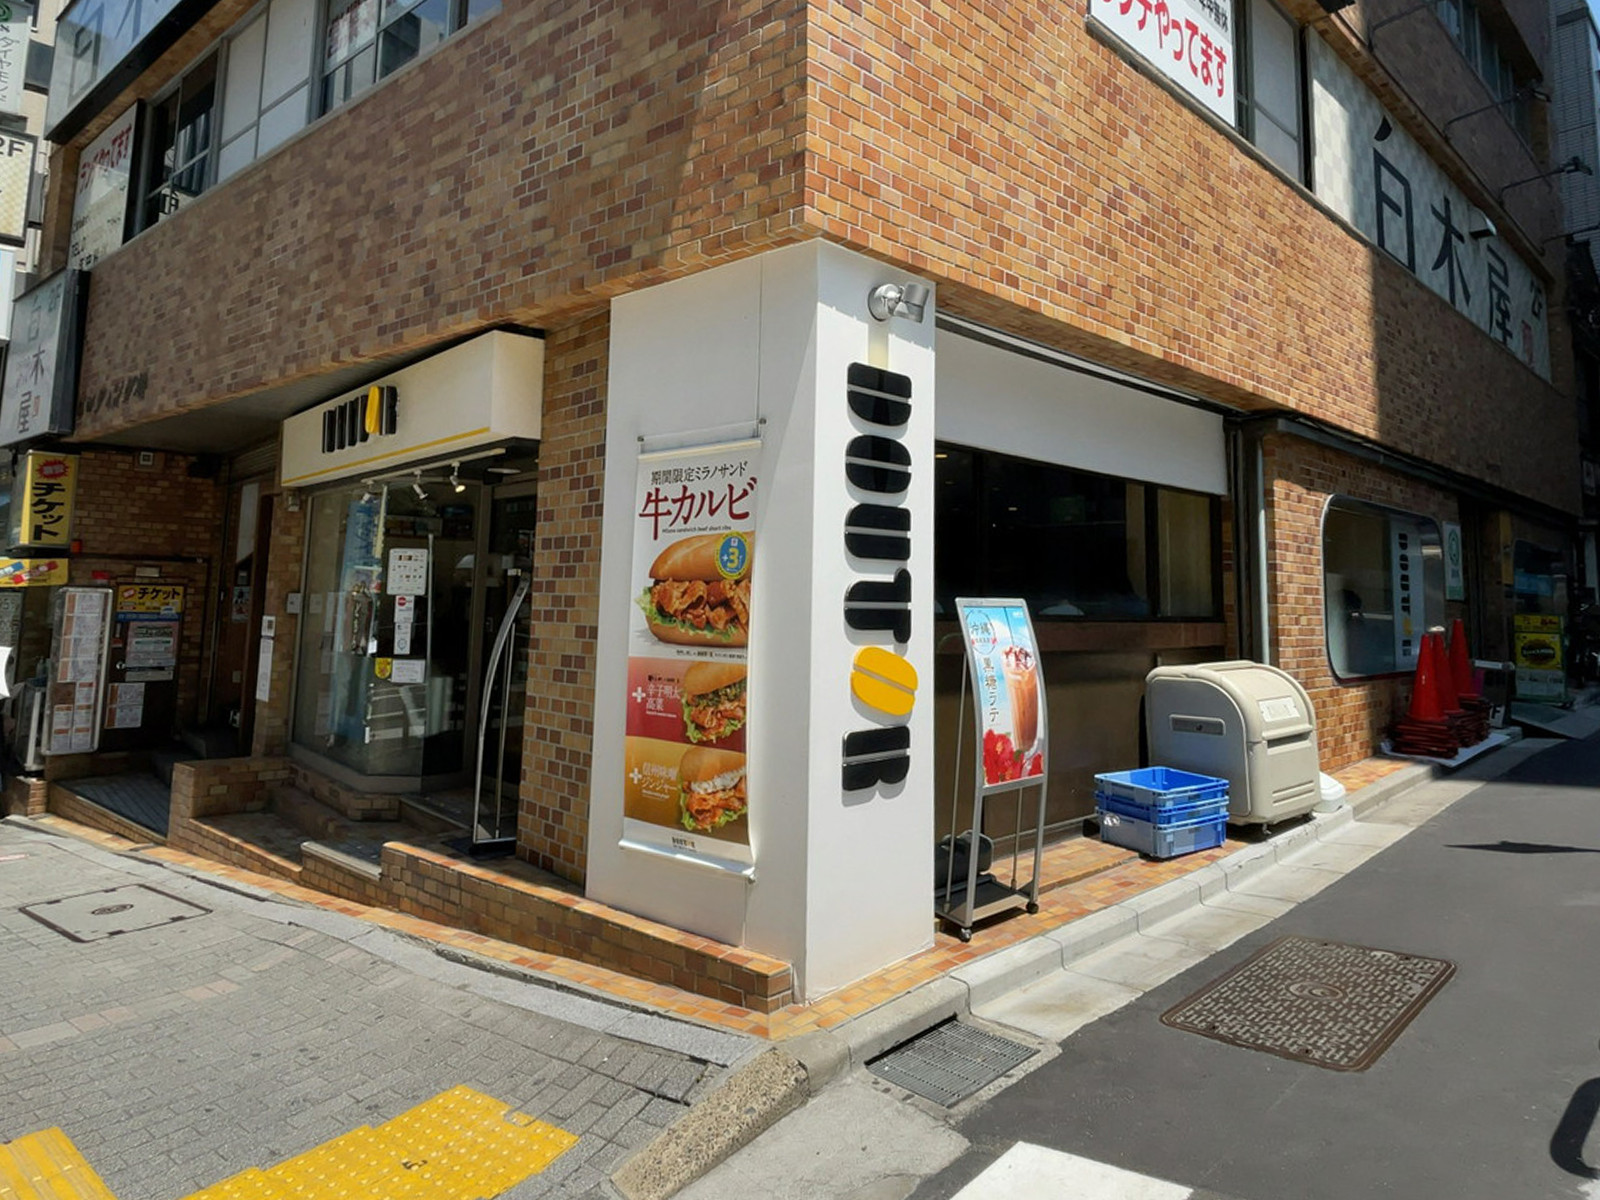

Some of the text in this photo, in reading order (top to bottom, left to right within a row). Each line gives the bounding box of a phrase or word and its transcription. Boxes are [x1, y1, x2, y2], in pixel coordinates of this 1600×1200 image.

[1373, 115, 1512, 346] 白木屋
[651, 460, 748, 486] 期間限定ミラノサンド
[31, 481, 66, 541] チケット
[638, 476, 757, 541] 牛カルビ
[137, 586, 181, 600] チケット
